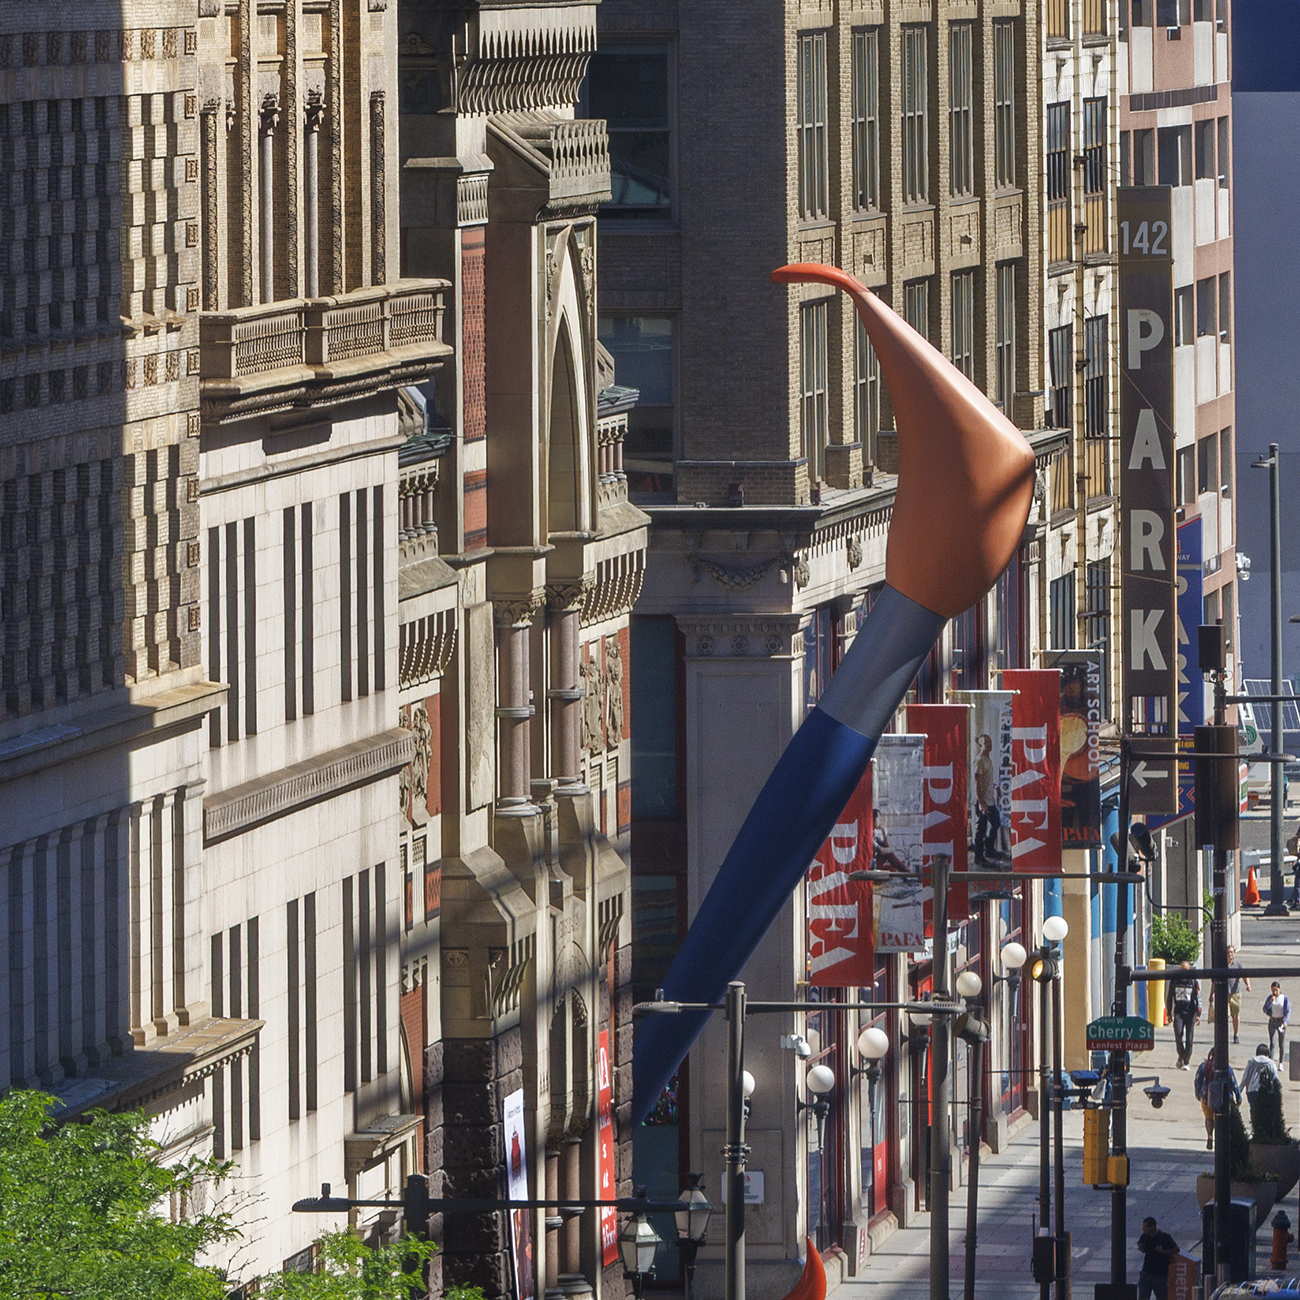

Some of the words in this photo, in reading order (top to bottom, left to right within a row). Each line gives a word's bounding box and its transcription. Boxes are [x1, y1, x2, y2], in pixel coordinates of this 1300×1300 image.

[1120, 220, 1169, 255] 142
[1127, 308, 1169, 671] PARK
[1086, 660, 1099, 693] ART
[1087, 698, 1102, 772] SCHOOL
[1012, 722, 1049, 860] PAFA
[1063, 827, 1100, 841] PAFA
[808, 820, 859, 973] PAFA
[881, 931, 924, 946] PAFA
[1089, 1025, 1133, 1040] Cherry
[1139, 1026, 1152, 1038] St
[1091, 1041, 1122, 1049] Lenfest
[1125, 1041, 1148, 1049] Plaza
